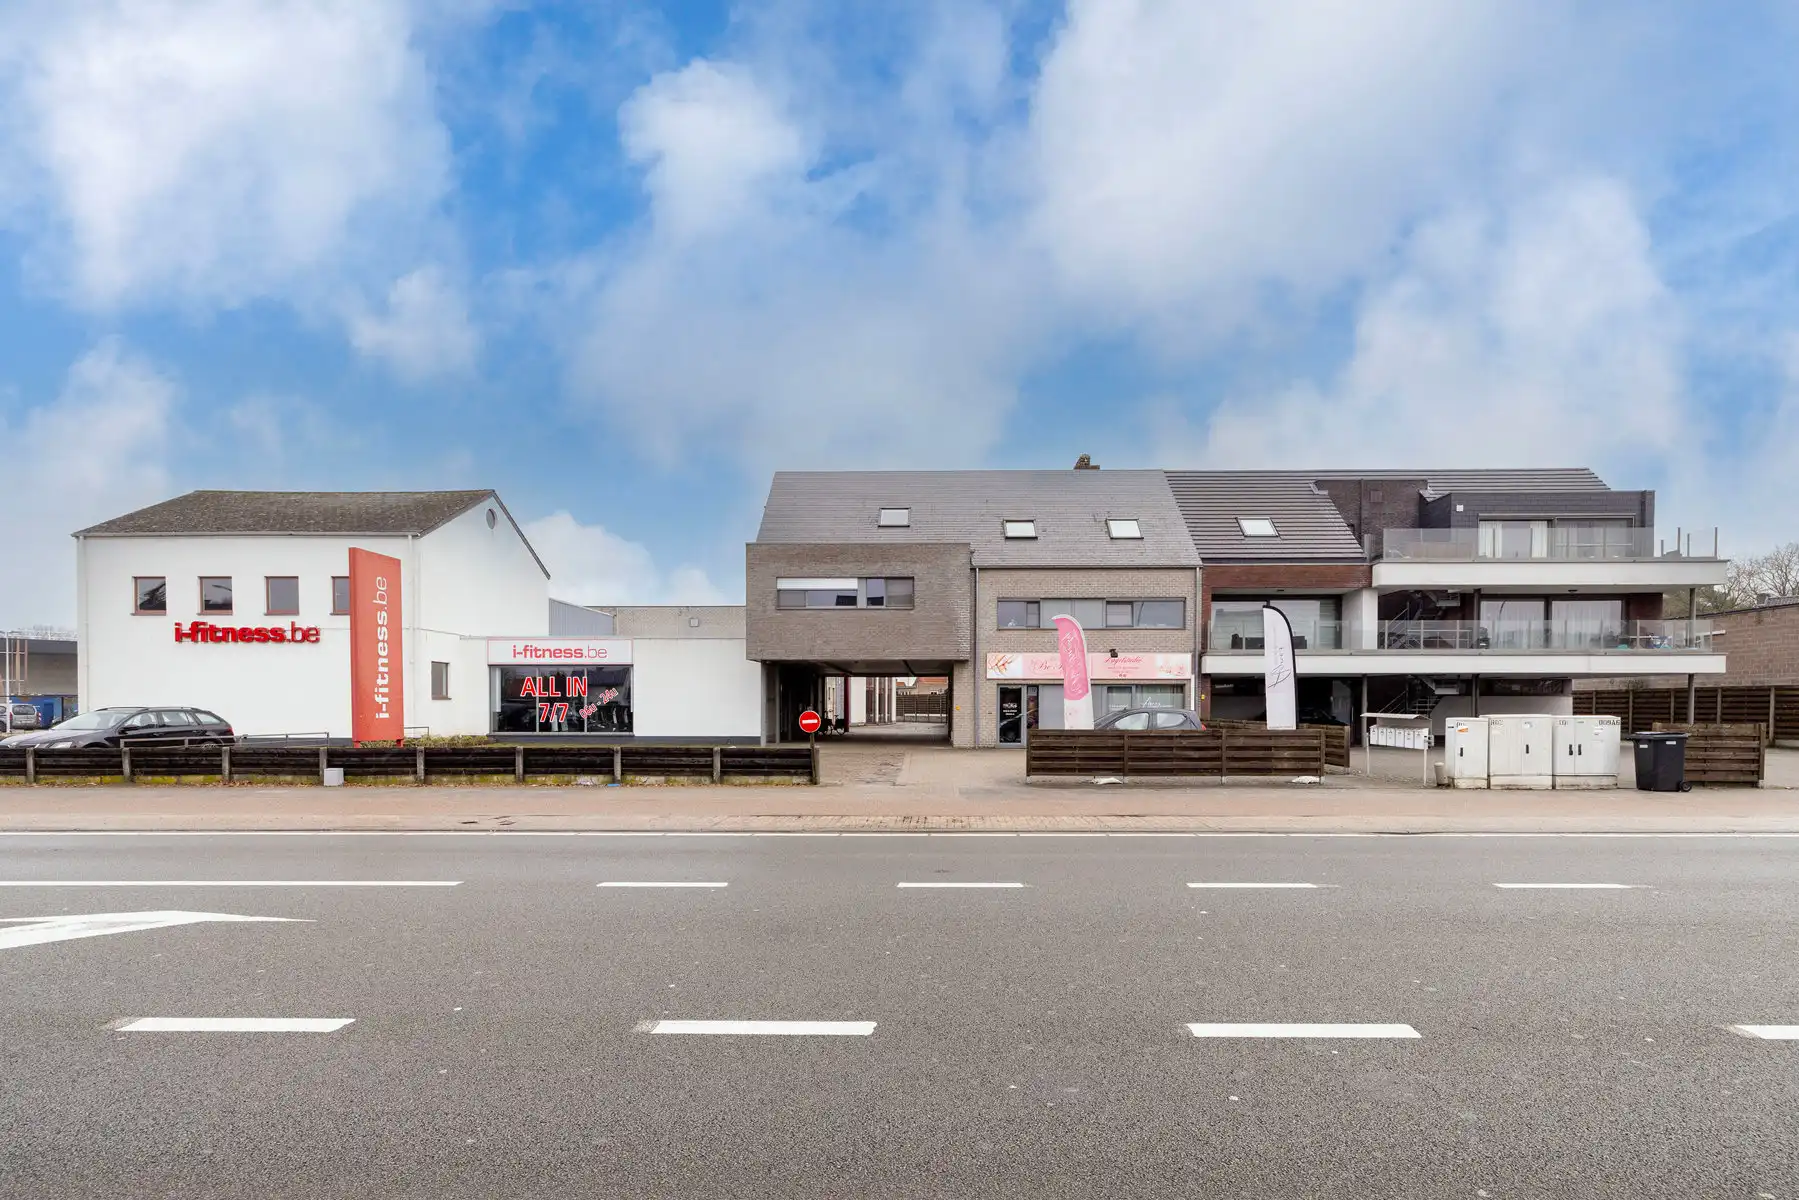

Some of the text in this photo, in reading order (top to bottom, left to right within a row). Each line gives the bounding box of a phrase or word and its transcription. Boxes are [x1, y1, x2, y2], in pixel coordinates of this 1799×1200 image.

[174, 621, 321, 644] i-fitness.be
[373, 576, 390, 720] i-fitness.be
[512, 644, 608, 659] i-fitness.be
[520, 676, 588, 698] ALL IN
[538, 702, 569, 723] 7/7
